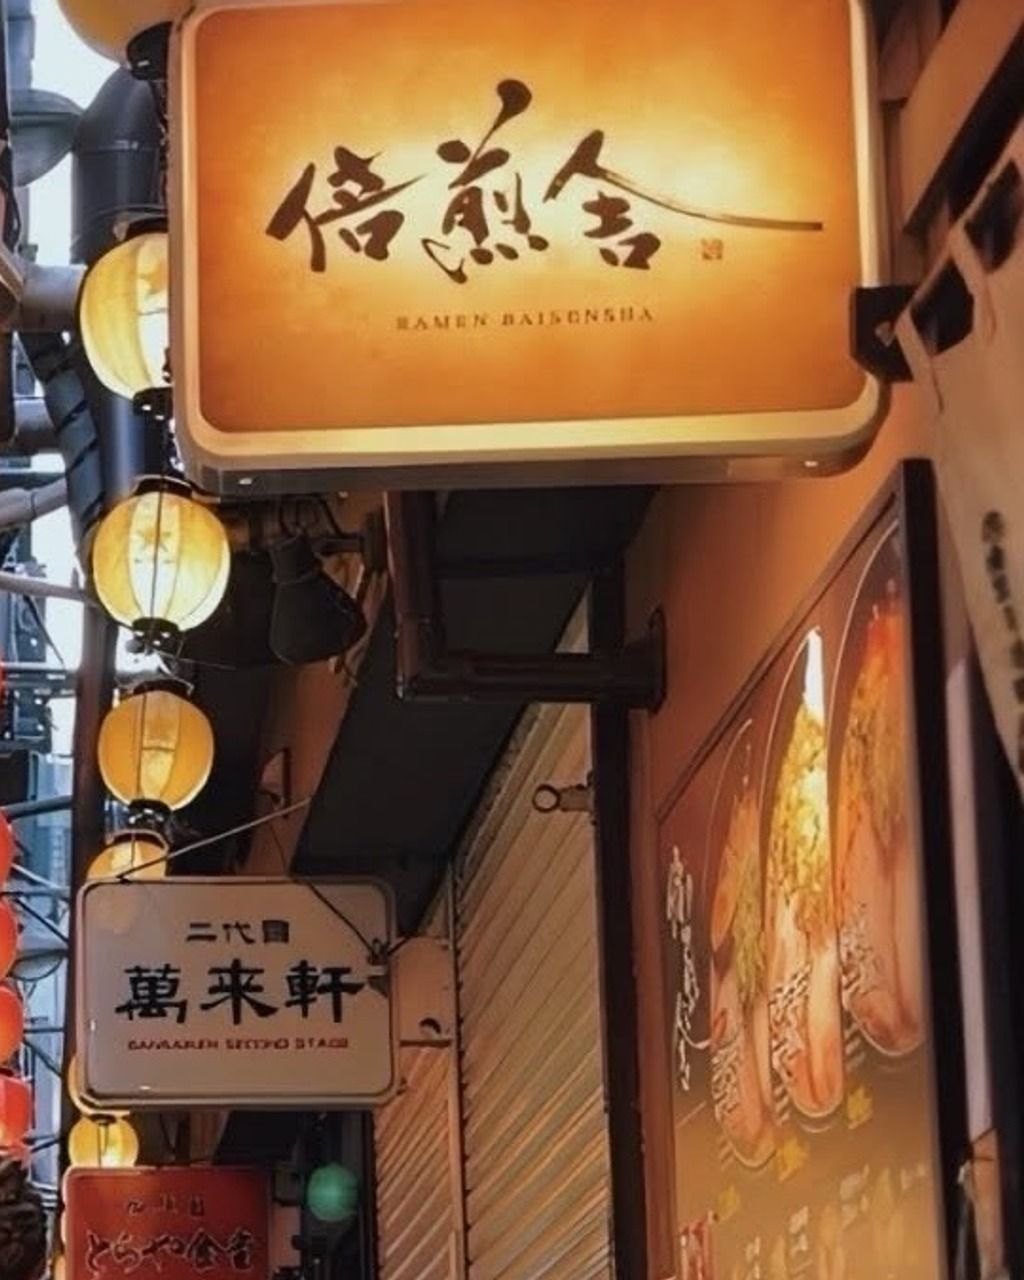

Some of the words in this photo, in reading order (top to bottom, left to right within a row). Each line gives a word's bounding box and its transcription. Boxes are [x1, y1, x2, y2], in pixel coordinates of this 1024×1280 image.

[396, 312, 488, 330] RAMEN
[185, 918, 291, 945] 二代目
[114, 958, 367, 1025] 萬来軒
